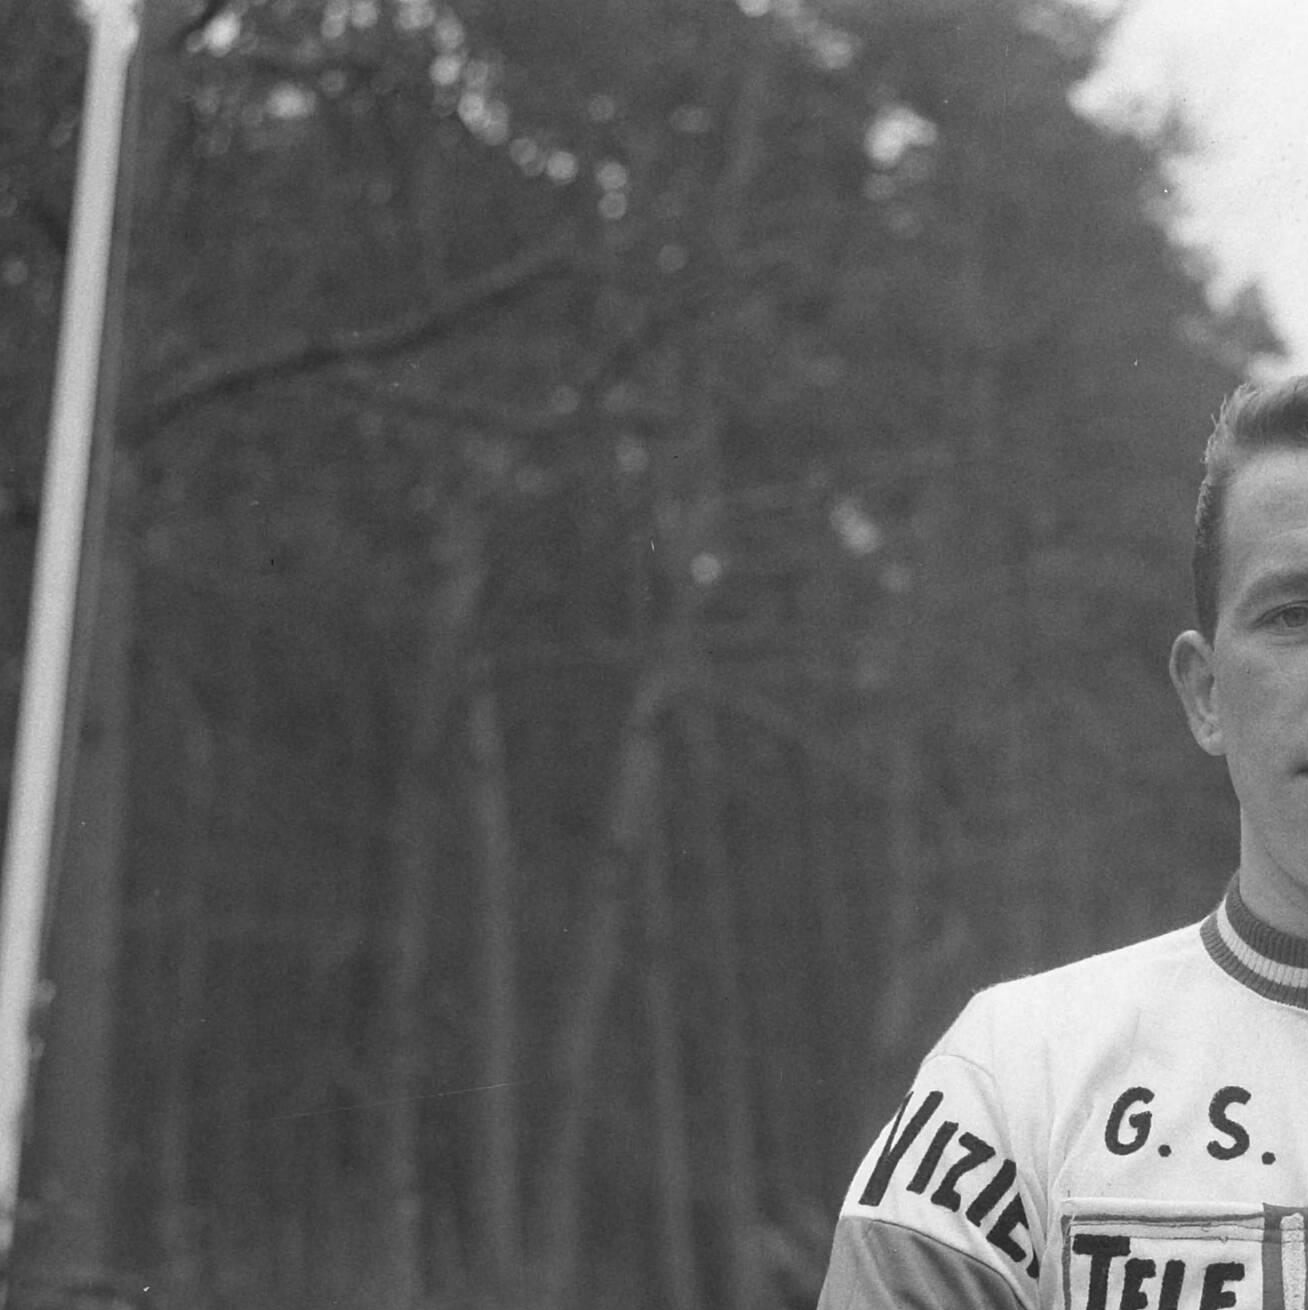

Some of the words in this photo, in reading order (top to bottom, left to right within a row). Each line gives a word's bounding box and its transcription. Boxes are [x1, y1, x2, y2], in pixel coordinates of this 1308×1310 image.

[858, 1090, 1040, 1279] VIZIE
[1104, 1086, 1173, 1158] G.
[1206, 1085, 1277, 1165] S.
